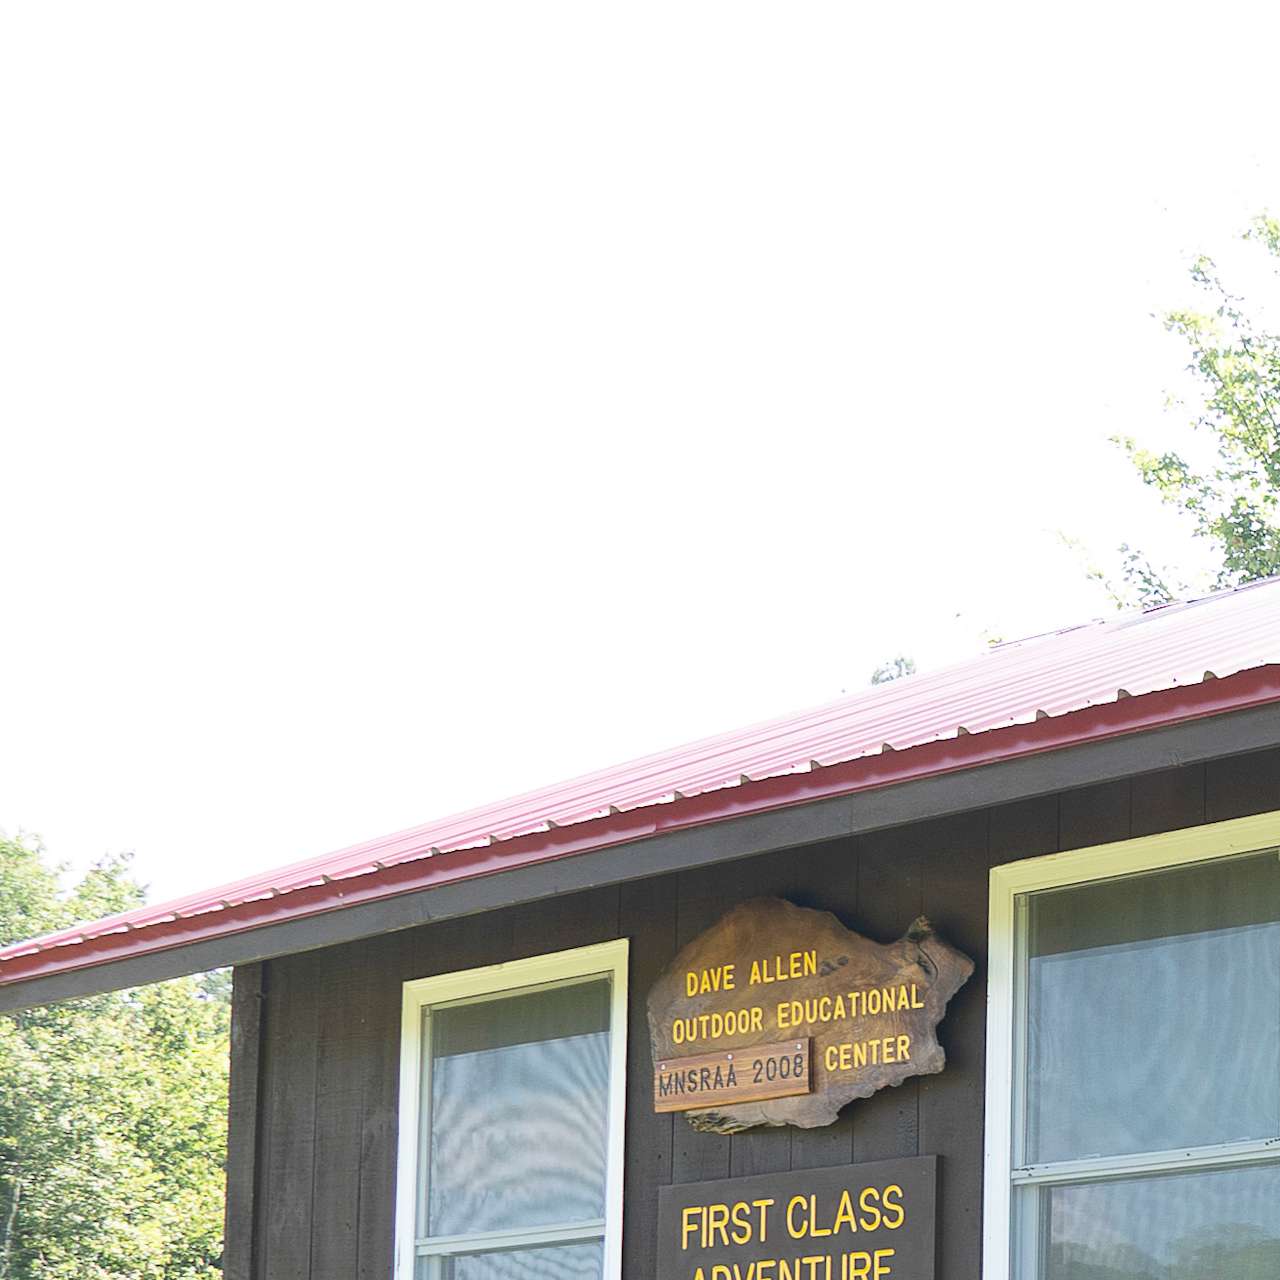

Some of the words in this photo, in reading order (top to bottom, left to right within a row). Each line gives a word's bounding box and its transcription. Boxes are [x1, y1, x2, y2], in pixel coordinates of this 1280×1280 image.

[686, 963, 736, 997] DAVE
[749, 949, 818, 984] ALLEN
[672, 1006, 764, 1045] OUTDOOR
[776, 983, 925, 1029] EDUCATIONAL
[659, 1063, 738, 1098] MNSRAA
[752, 1053, 804, 1084] 2008
[824, 1034, 911, 1072] CENTER
[681, 1198, 775, 1250] FIRST
[786, 1184, 905, 1240] CLASS
